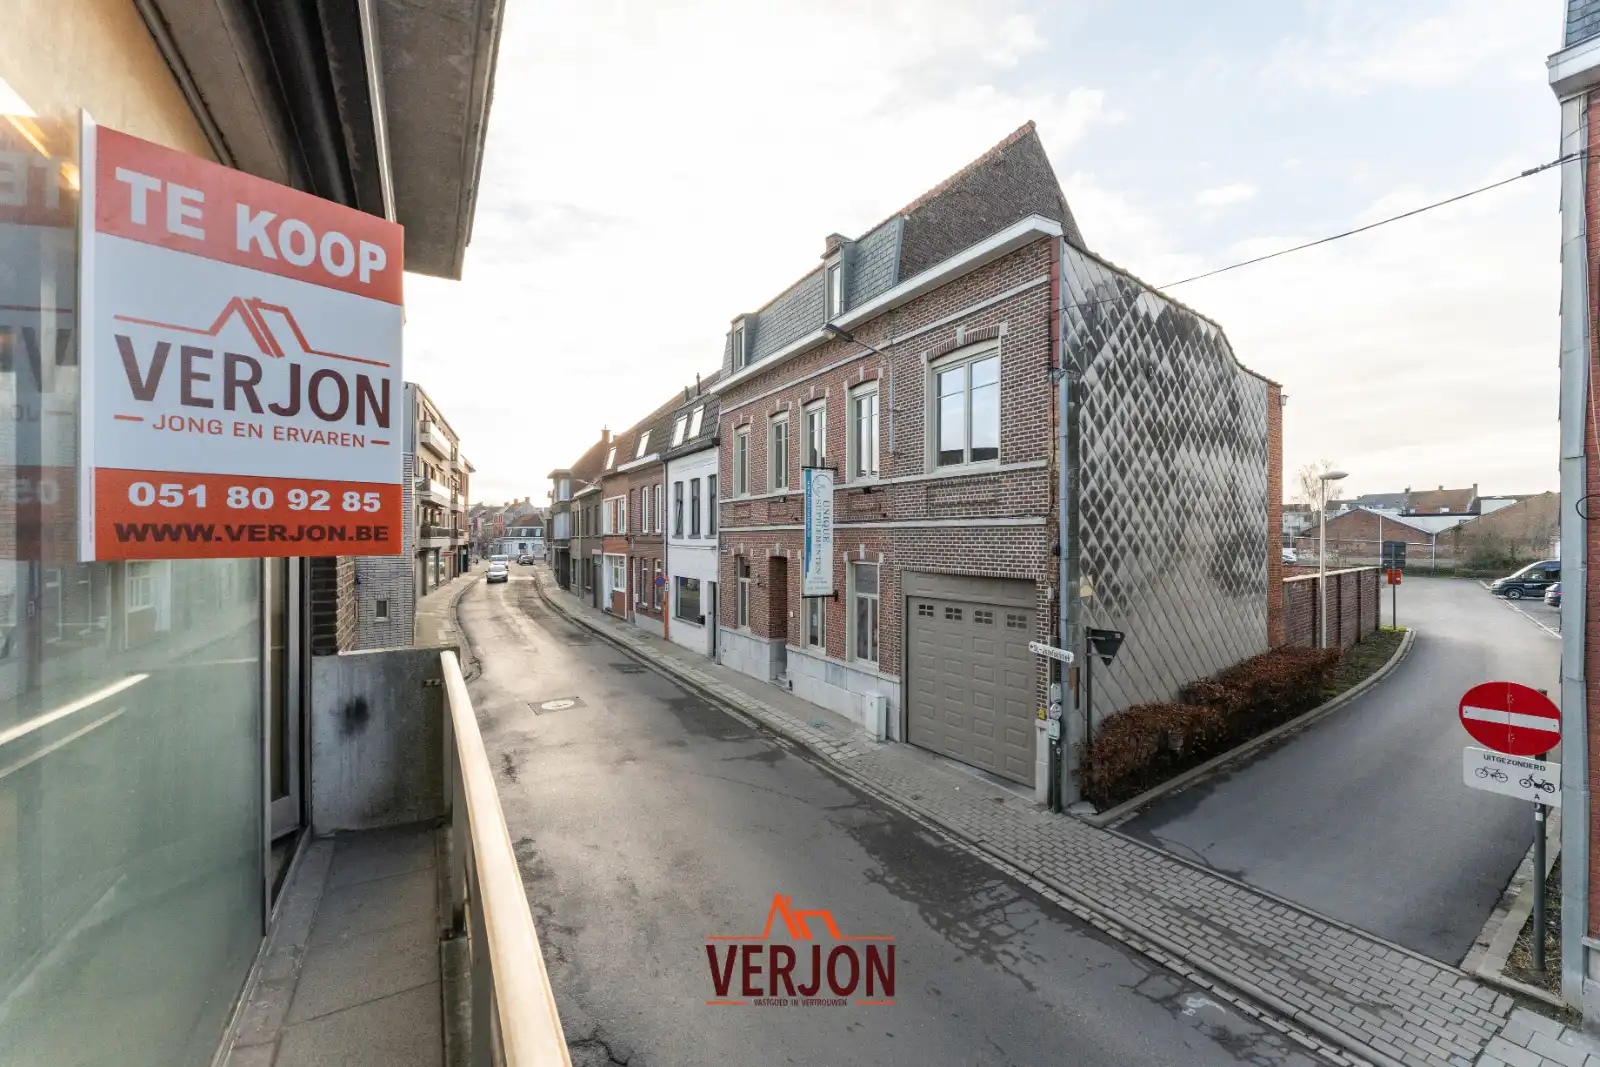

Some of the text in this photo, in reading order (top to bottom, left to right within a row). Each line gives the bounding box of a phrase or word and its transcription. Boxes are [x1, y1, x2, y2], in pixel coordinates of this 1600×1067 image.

[115, 167, 387, 284] TE KOOP
[114, 334, 391, 429] VERJON
[152, 413, 366, 449] JONG EN ERVAREN
[127, 481, 381, 513] 051 80 92 85
[115, 522, 390, 543] WWW.VERJON.BE
[822, 500, 831, 543] UNIQUE
[1483, 754, 1546, 772] UITGEZONDERD
